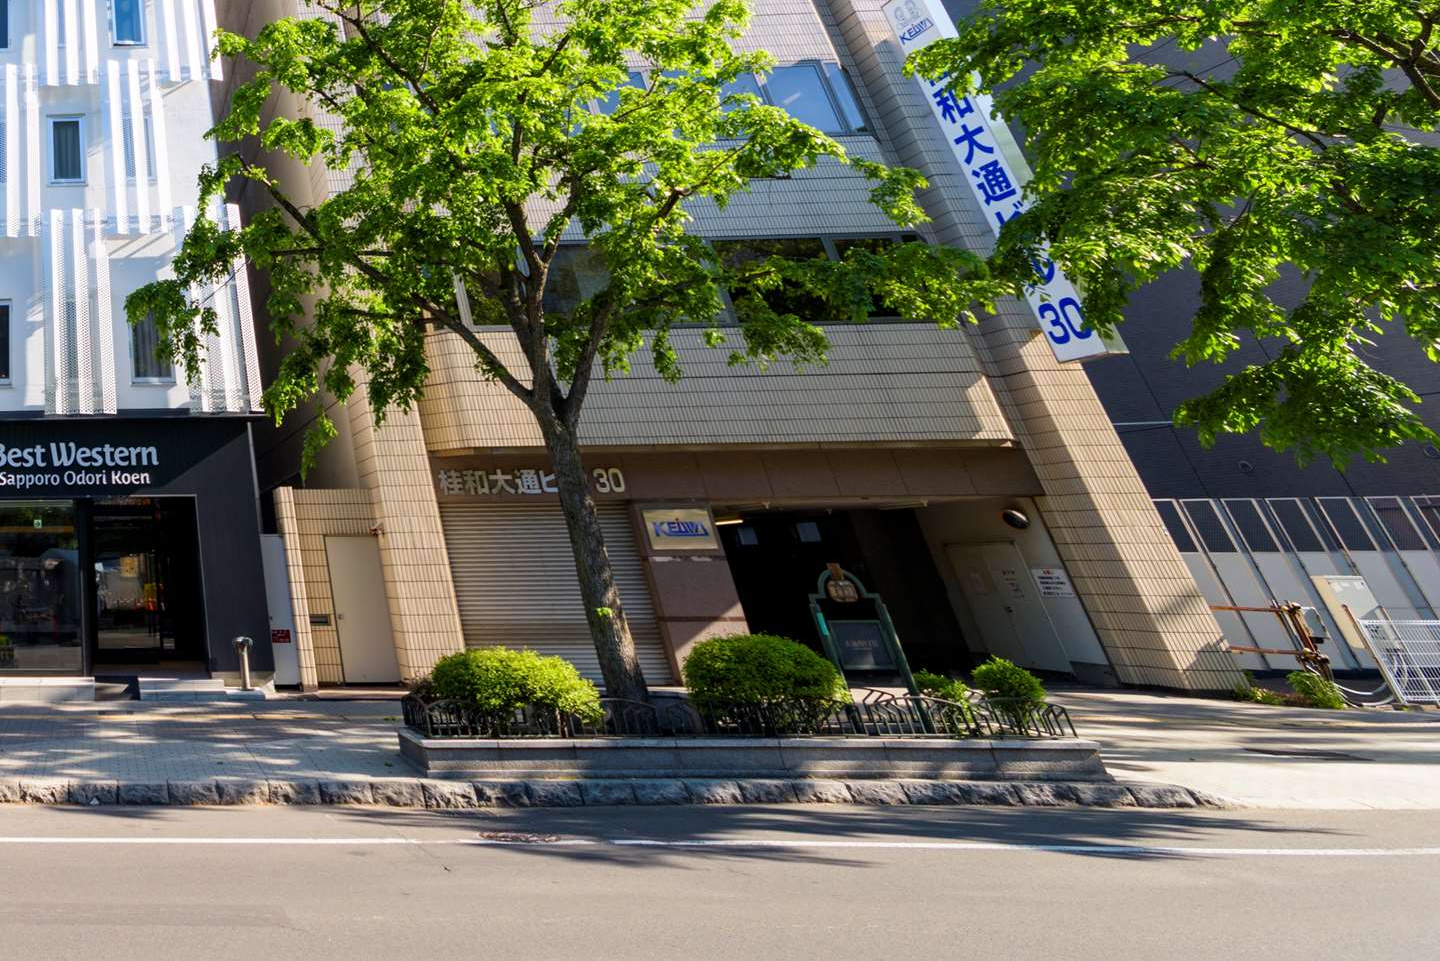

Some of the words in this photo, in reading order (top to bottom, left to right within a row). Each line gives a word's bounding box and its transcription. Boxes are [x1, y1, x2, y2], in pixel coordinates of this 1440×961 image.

[1038, 297, 1092, 345] 30
[49, 442, 159, 467] Western
[64, 470, 107, 485] Odori
[111, 471, 151, 485] Koen
[592, 468, 625, 493] 30
